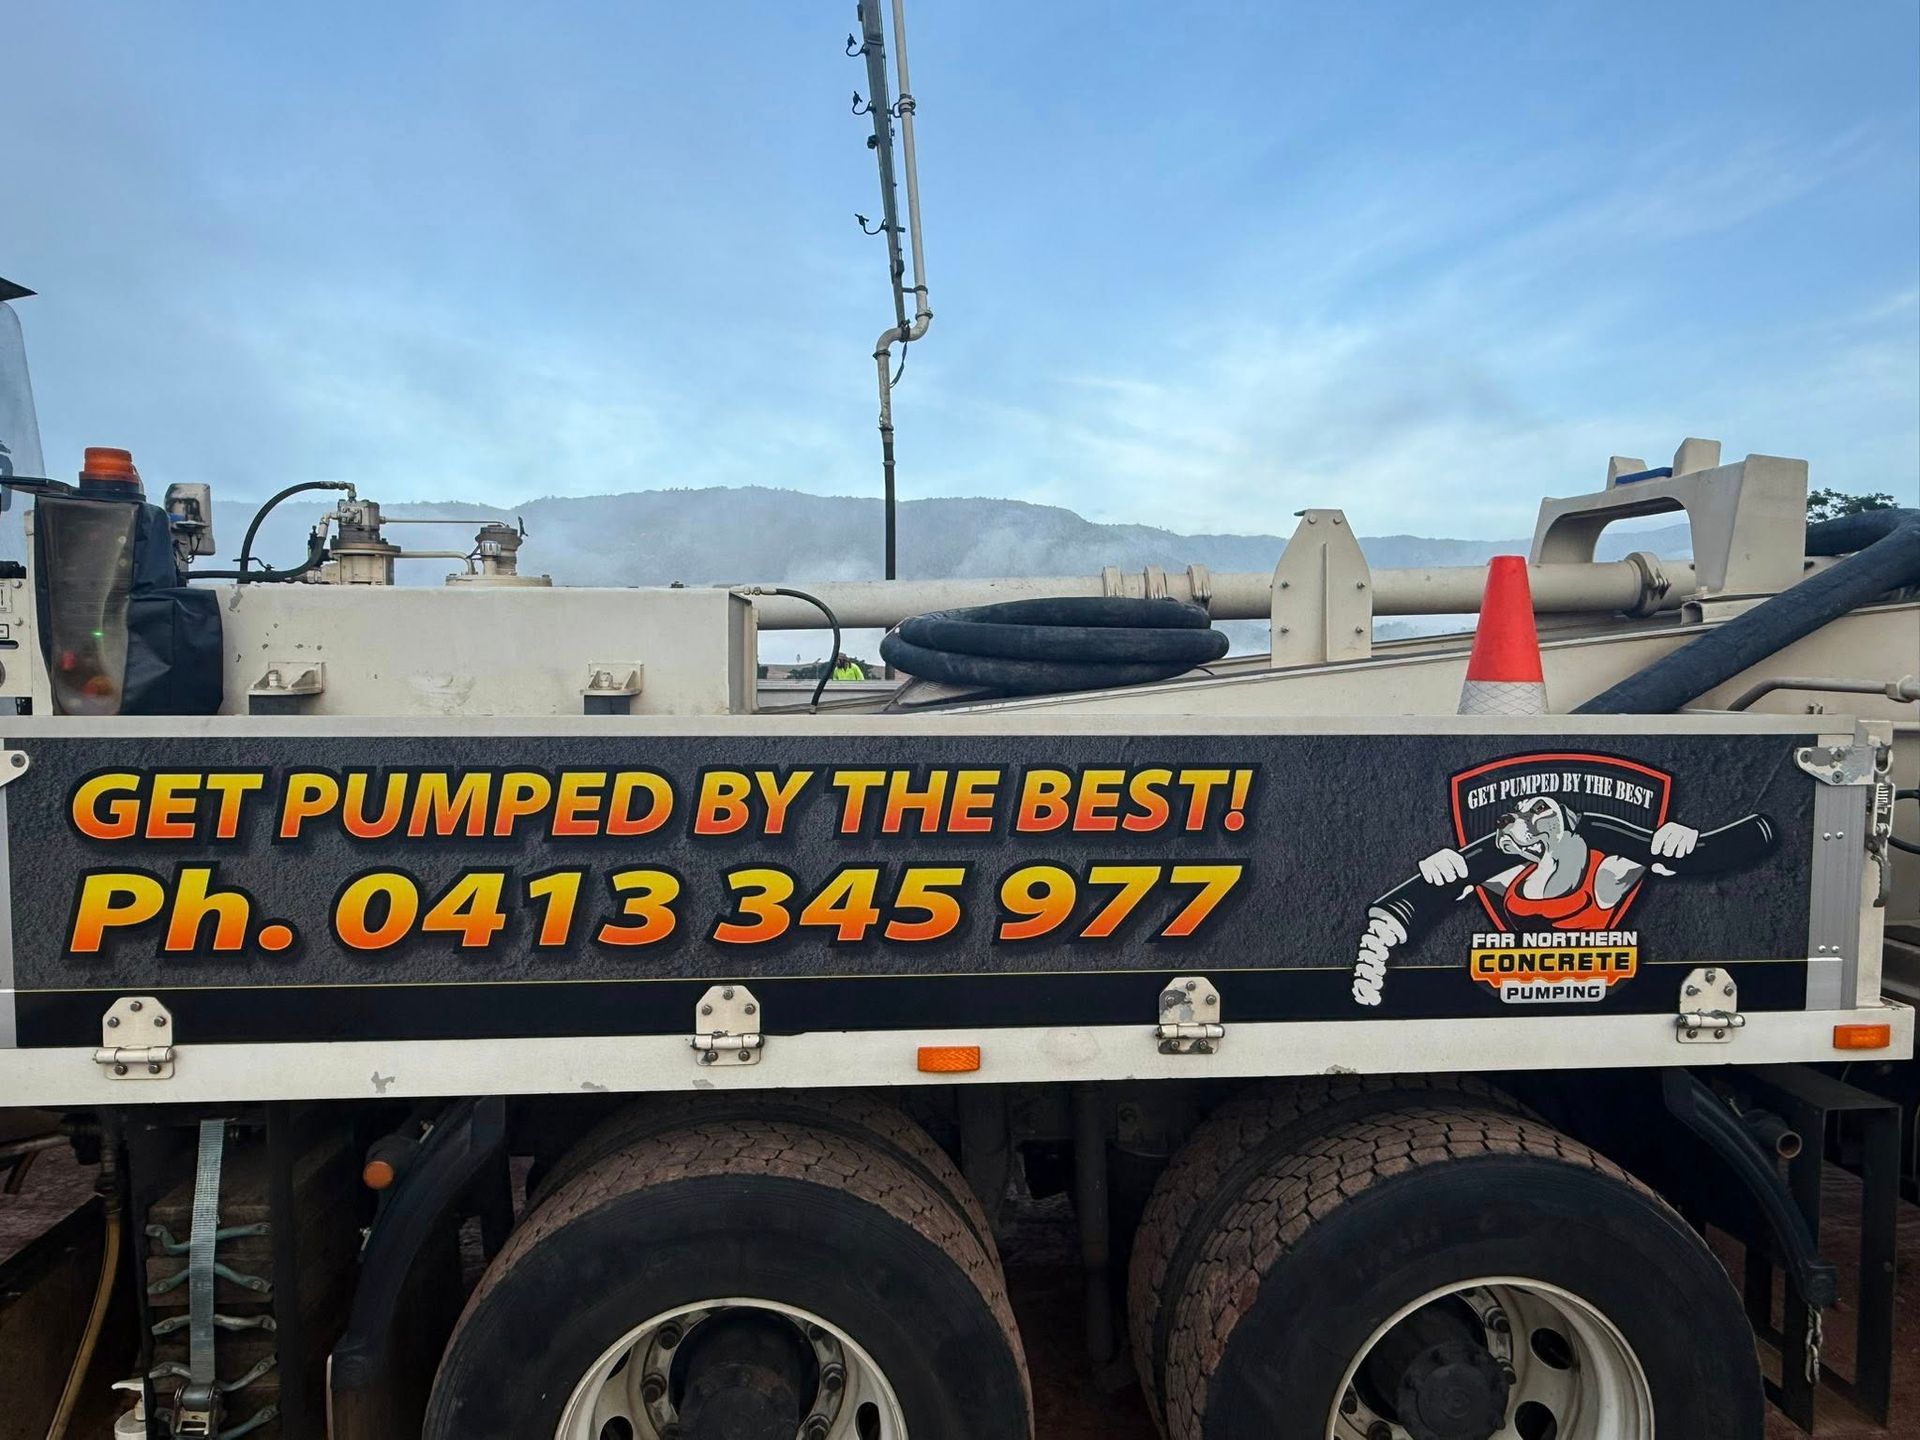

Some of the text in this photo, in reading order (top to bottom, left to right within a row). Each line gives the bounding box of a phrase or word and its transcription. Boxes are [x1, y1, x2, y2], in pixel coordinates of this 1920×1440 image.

[72, 769, 1254, 839] GET PUMPED BY THE BEST!
[1467, 773, 1654, 810] GET PUMPED BY THE BEST
[69, 865, 1243, 953] Ph. 0413 345 977
[1472, 931, 1638, 948] FAR NORTHERN
[1478, 952, 1630, 973] CONCRETE
[1506, 985, 1600, 1000] PUMPING
